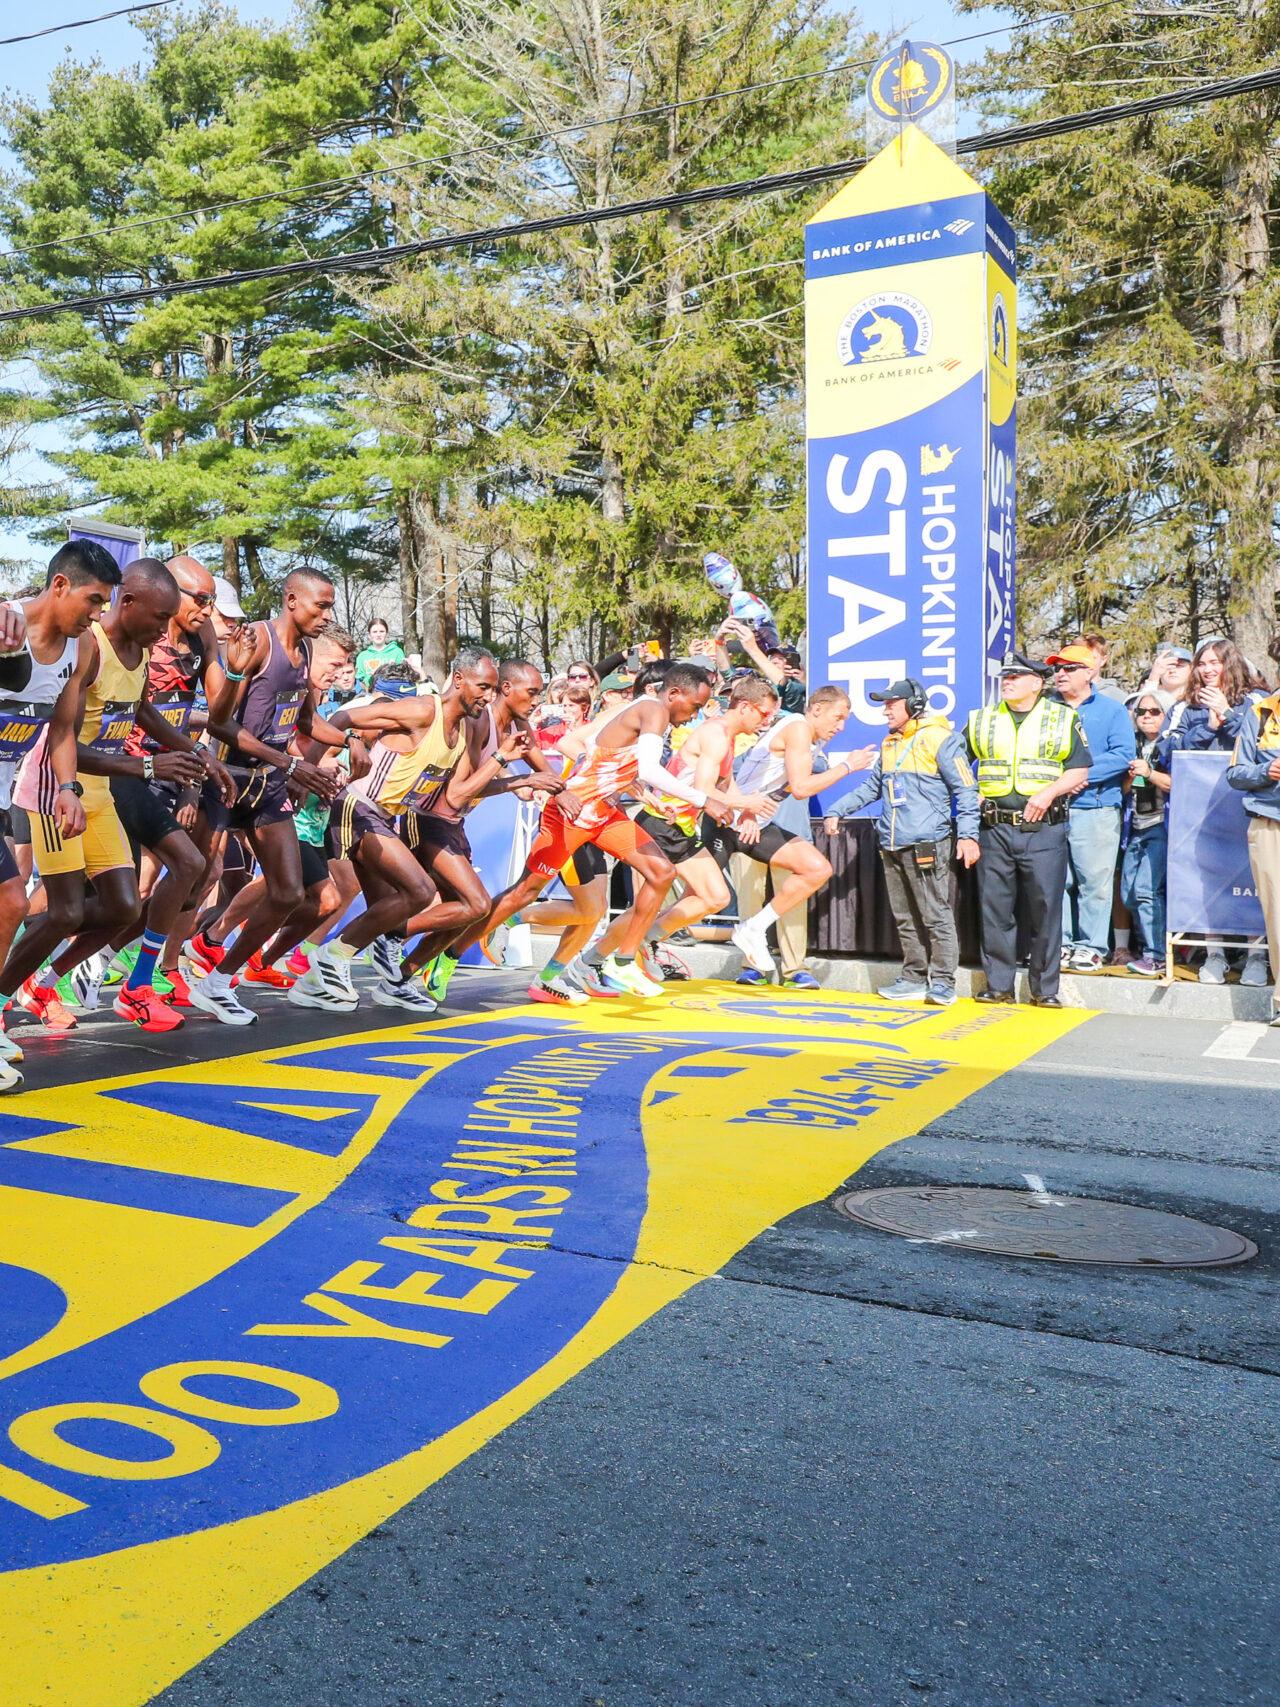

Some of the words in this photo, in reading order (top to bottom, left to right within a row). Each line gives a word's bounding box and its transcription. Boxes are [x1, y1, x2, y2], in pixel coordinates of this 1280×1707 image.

[812, 244, 851, 260] BANK
[853, 240, 872, 254] OF
[874, 229, 941, 250] AMERICA
[845, 296, 886, 329] BOSTON
[894, 295, 930, 347] MARATHON
[825, 376, 856, 387] BANK
[860, 373, 875, 383] OF
[878, 365, 934, 380] AMERICA
[1001, 496, 1013, 654] HOPKIN
[921, 485, 956, 733] HOPKINTO
[537, 862, 561, 876] INE
[725, 1055, 960, 1130] 1924-2024
[244, 1179, 572, 1349] YEARS
[462, 1034, 713, 1138] HOPKINTON
